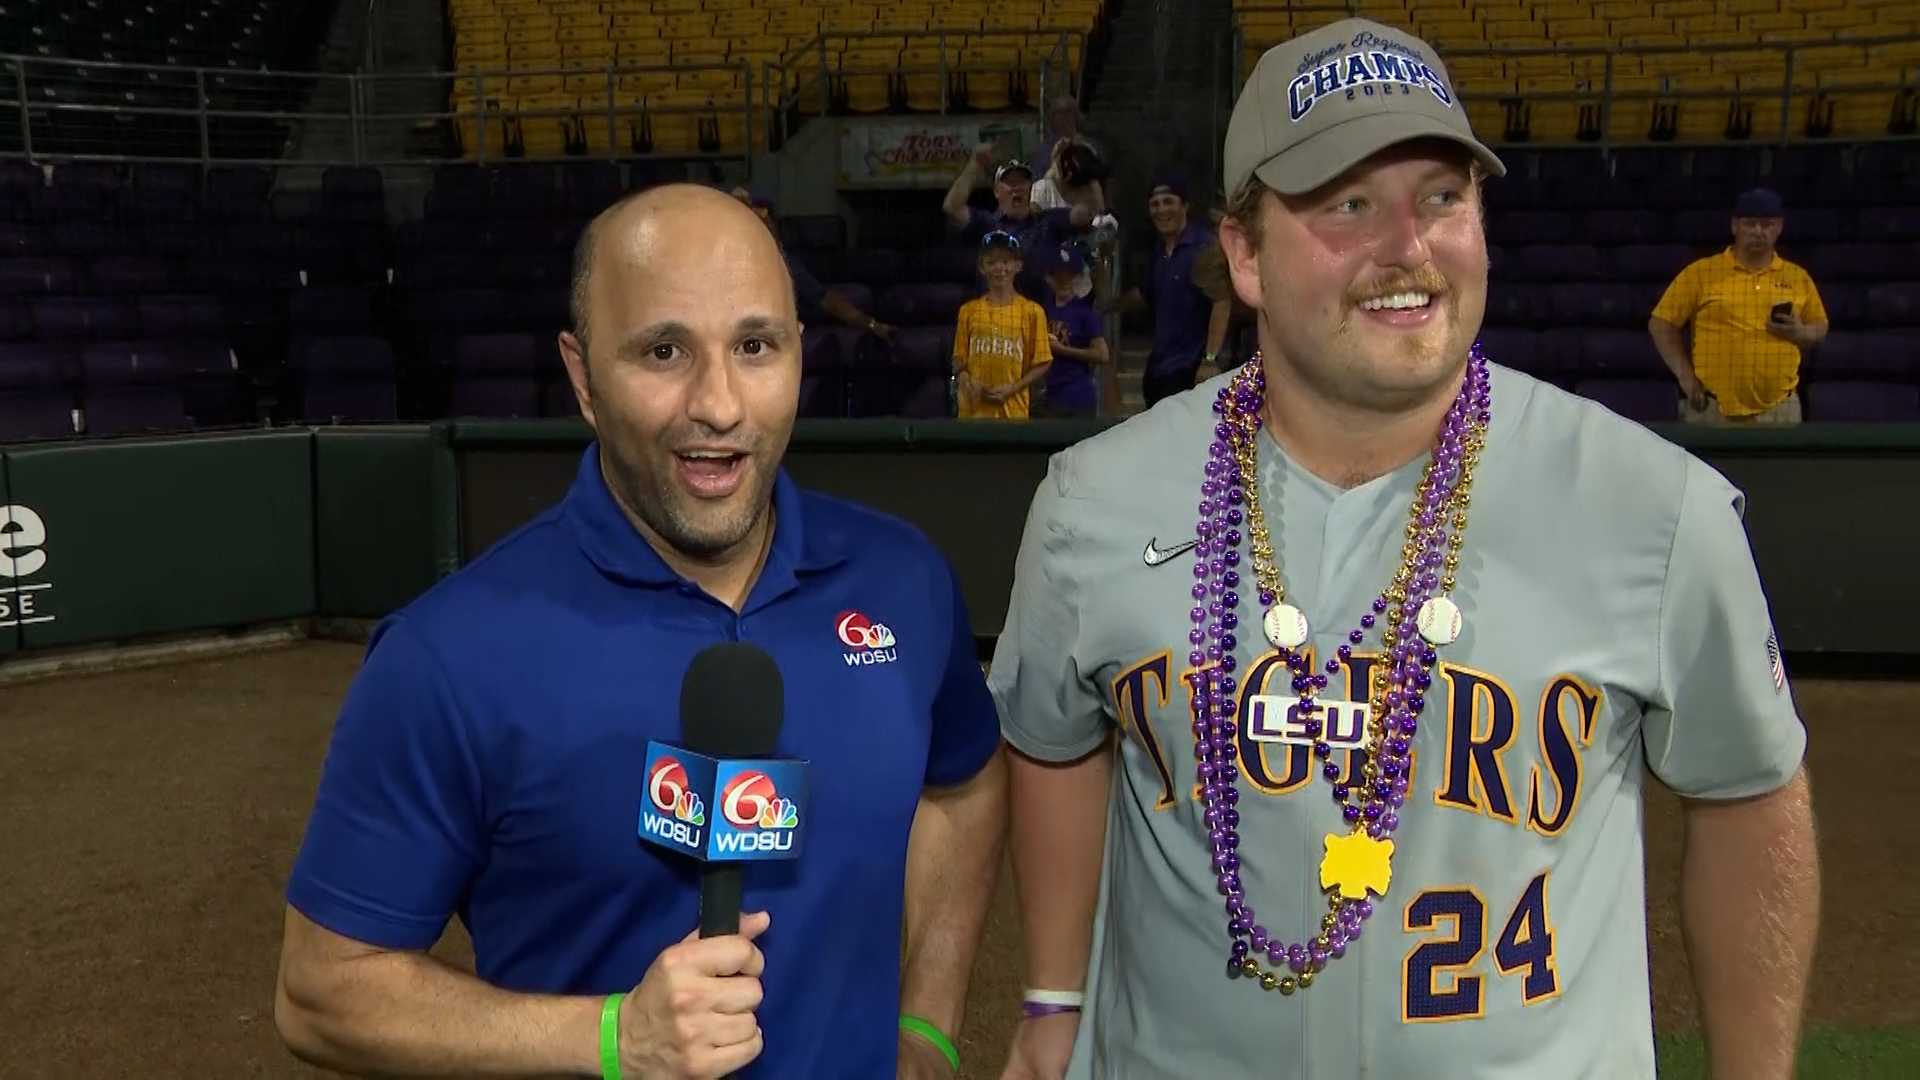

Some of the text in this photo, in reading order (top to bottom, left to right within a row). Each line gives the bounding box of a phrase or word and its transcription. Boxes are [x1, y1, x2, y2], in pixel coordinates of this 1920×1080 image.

[1287, 50, 1453, 122] CHAMPS
[1345, 83, 1411, 101] 2023
[838, 612, 869, 646] 6
[843, 647, 897, 666] WDSU
[1252, 701, 1365, 743] LSU
[650, 762, 685, 811] 6
[723, 774, 770, 825] 6
[643, 811, 701, 848] WDSU
[716, 831, 794, 852] WDSU
[1401, 868, 1562, 1024] 24
